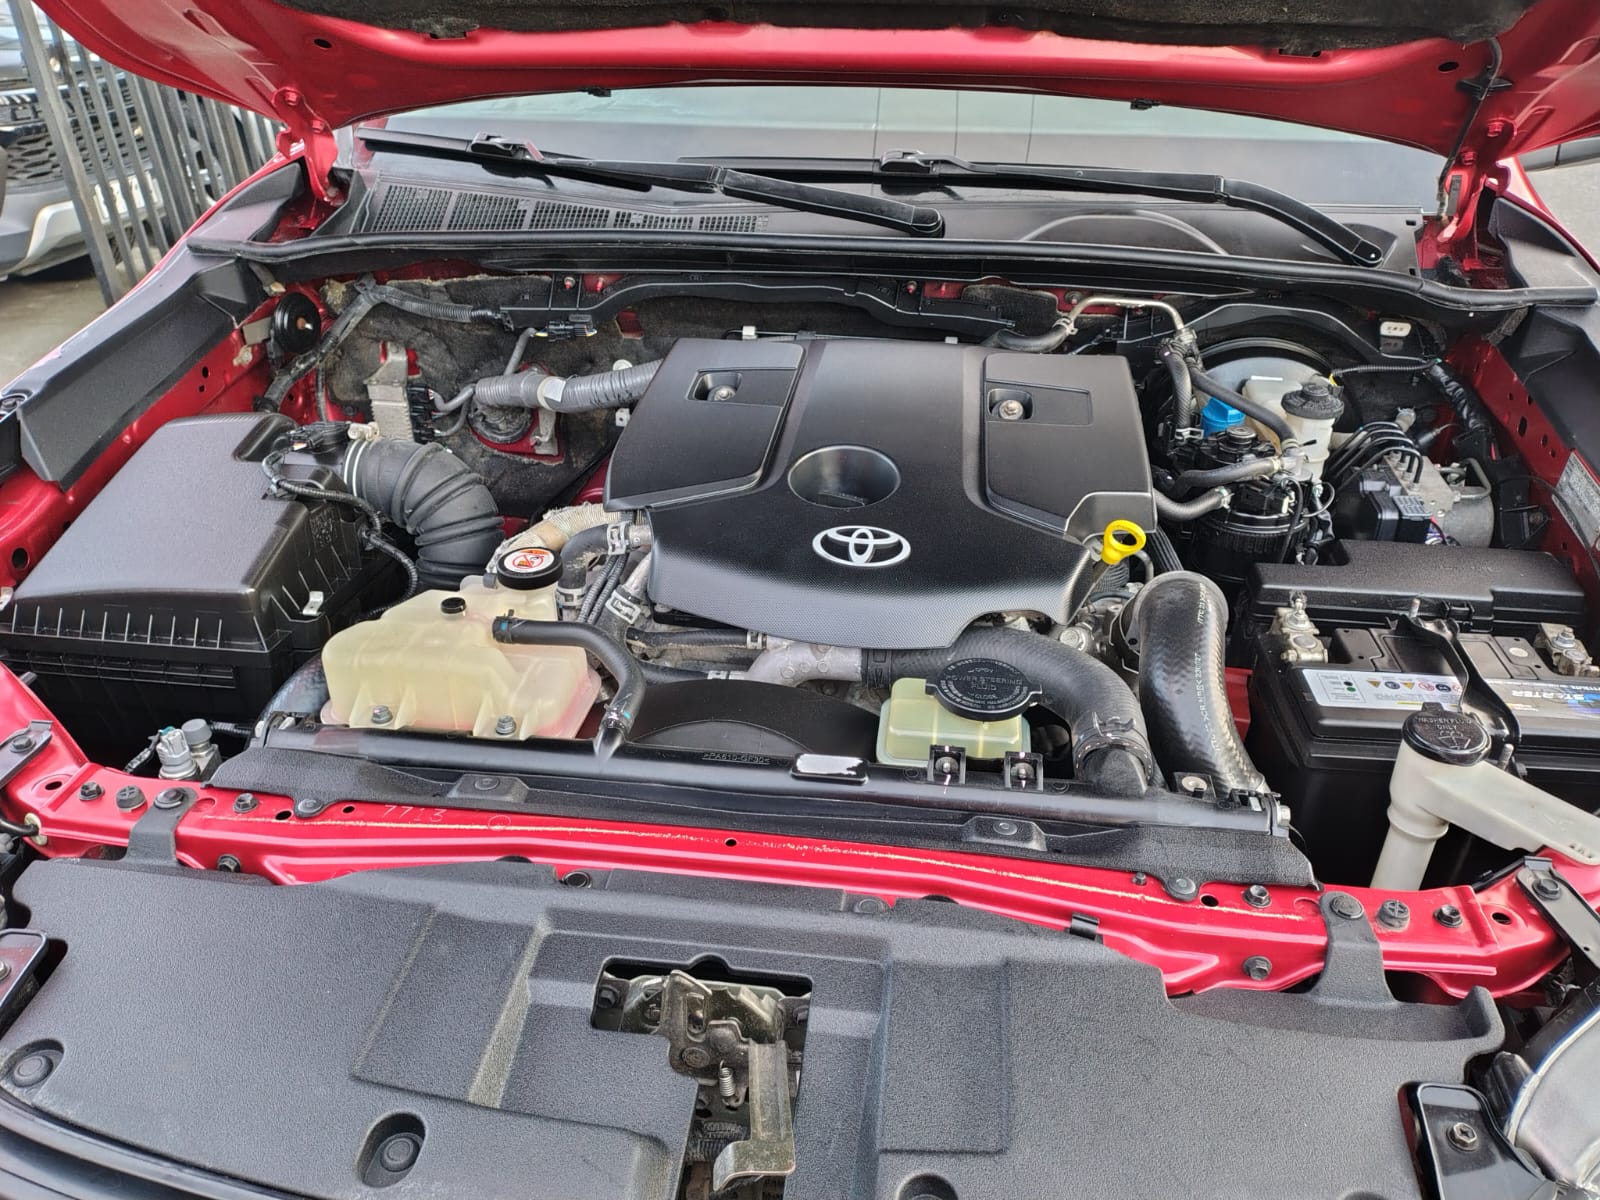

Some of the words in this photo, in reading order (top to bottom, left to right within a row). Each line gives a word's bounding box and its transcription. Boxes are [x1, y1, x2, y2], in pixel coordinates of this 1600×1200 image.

[979, 676, 1023, 685] STEERING
[970, 682, 997, 691] FLUID
[1511, 689, 1585, 701] STARTER
